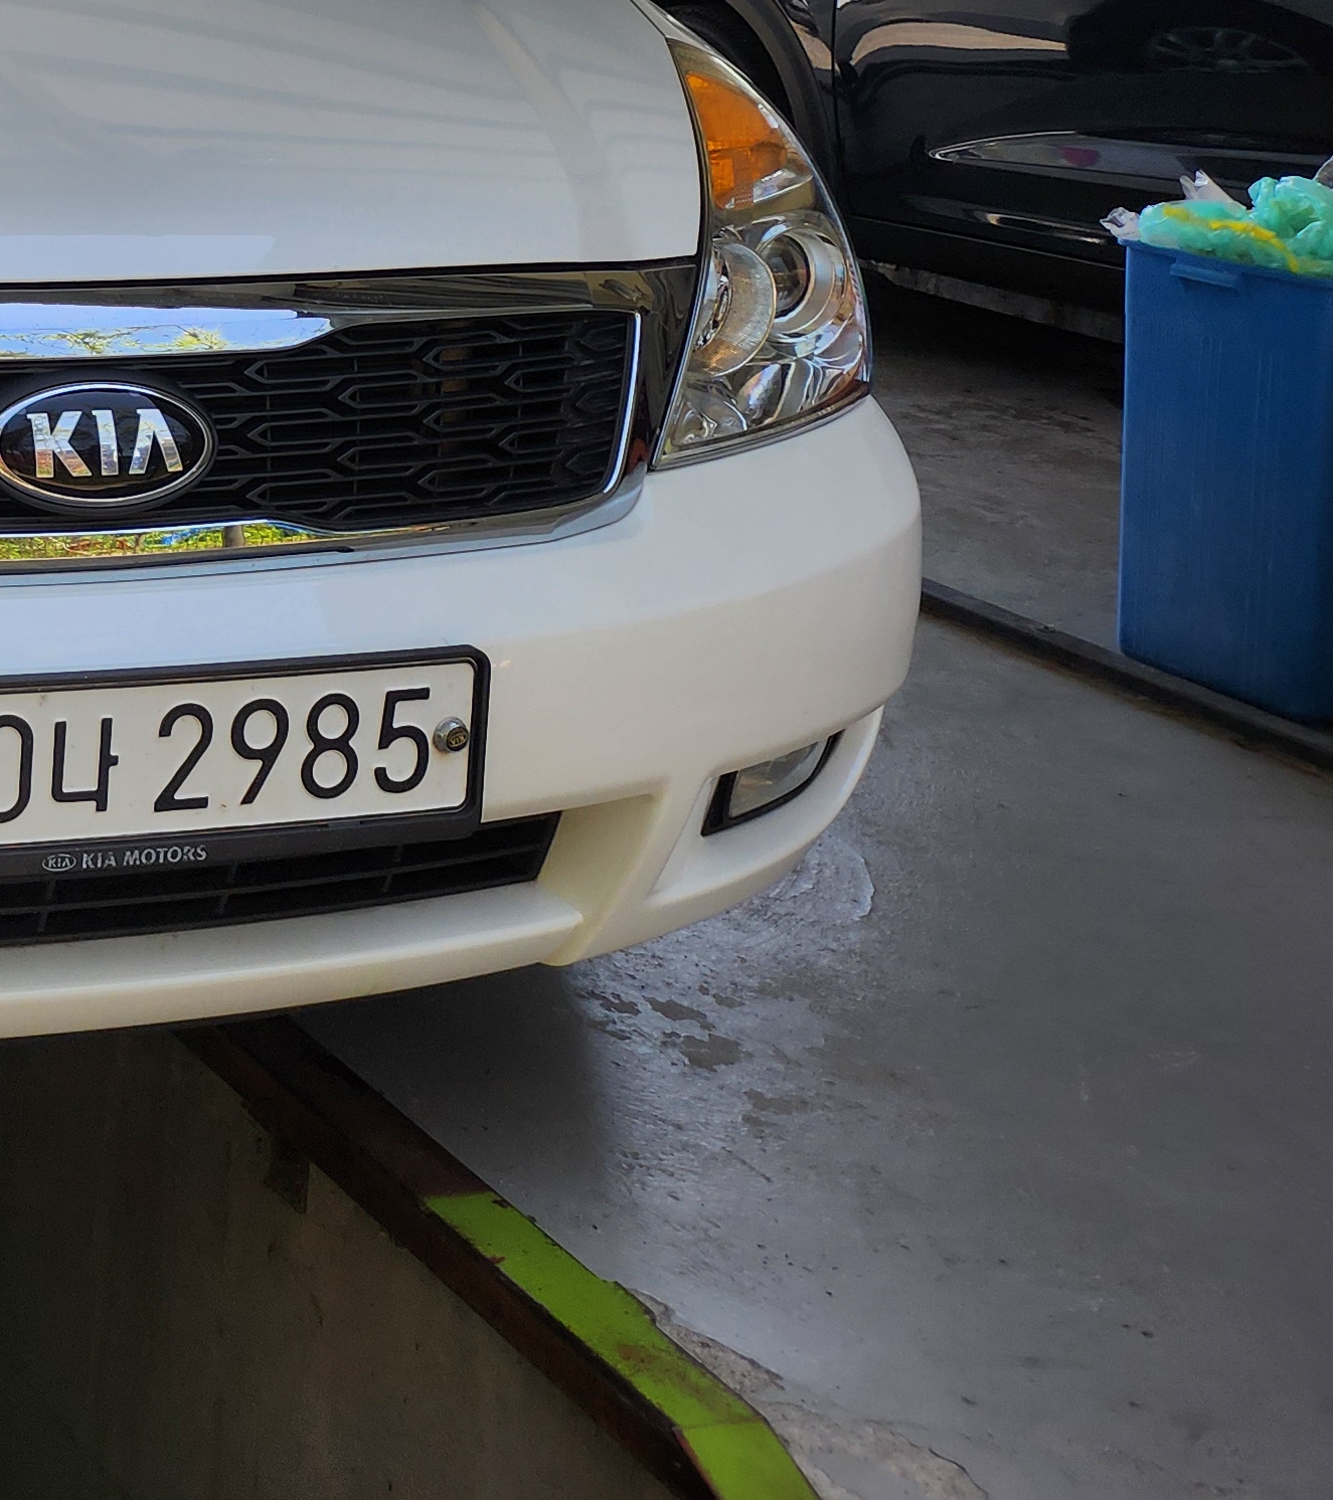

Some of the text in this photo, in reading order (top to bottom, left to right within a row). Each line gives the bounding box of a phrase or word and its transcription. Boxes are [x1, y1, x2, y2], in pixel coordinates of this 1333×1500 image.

[26, 408, 184, 479] KIA
[152, 686, 432, 814] 2985
[82, 852, 117, 869] KIA
[123, 845, 207, 866] MOTORS
